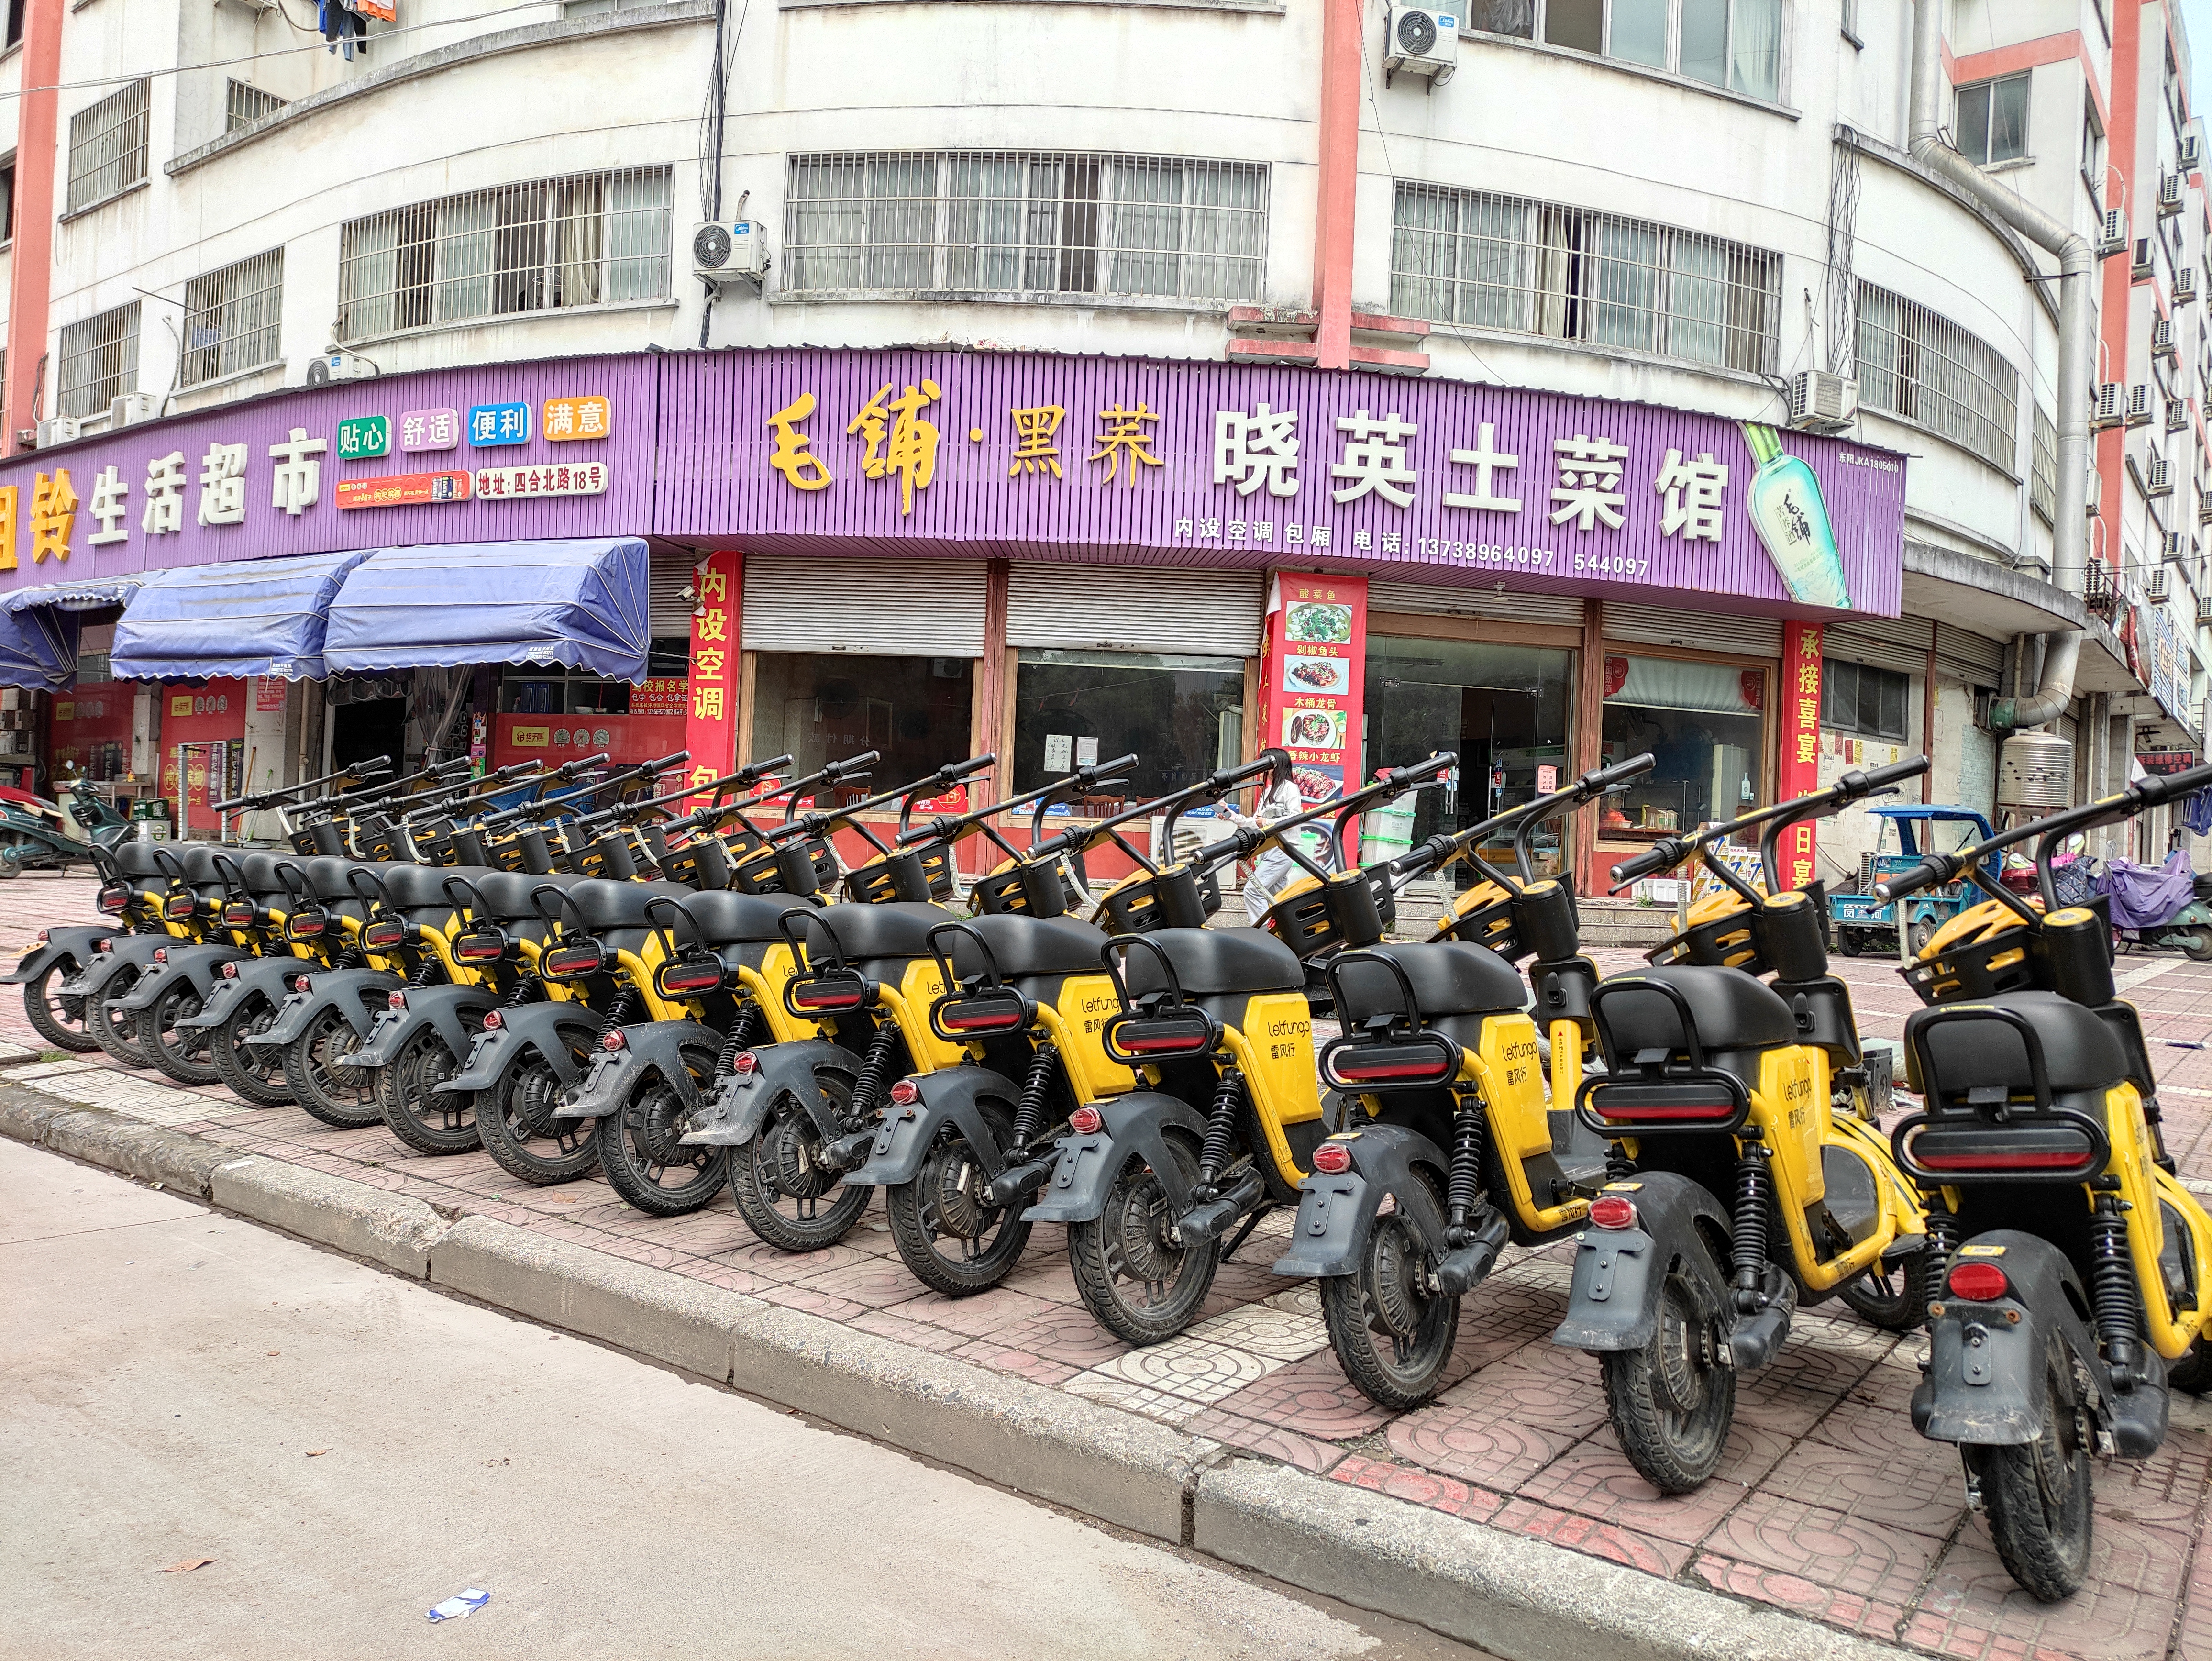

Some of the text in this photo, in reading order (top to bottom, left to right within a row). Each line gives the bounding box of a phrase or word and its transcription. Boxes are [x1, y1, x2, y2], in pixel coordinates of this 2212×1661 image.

[403, 413, 451, 446] 舒适
[472, 407, 524, 441] 便利
[546, 402, 604, 435] 满意
[340, 422, 384, 454] 贴心
[478, 466, 601, 495] 地址:四合北路18号
[1214, 402, 1728, 543] 晓英土菜馆
[1284, 521, 1331, 547] 包厢
[1574, 554, 1648, 576] 544097
[1299, 588, 1337, 601] 酸菜鱼
[693, 567, 727, 721] 内设空调
[1296, 644, 1339, 657] 剁椒鱼头
[632, 693, 688, 702] 包学 包会 包拿证
[1294, 697, 1337, 709] 木桶龙骨
[1796, 629, 1819, 764] 承接喜宴
[1288, 750, 1341, 763] 香辣小龙虾
[1081, 997, 1120, 1013] letfung
[1271, 1043, 1295, 1060] 雷风行
[1506, 1066, 1527, 1086] 雷风行
